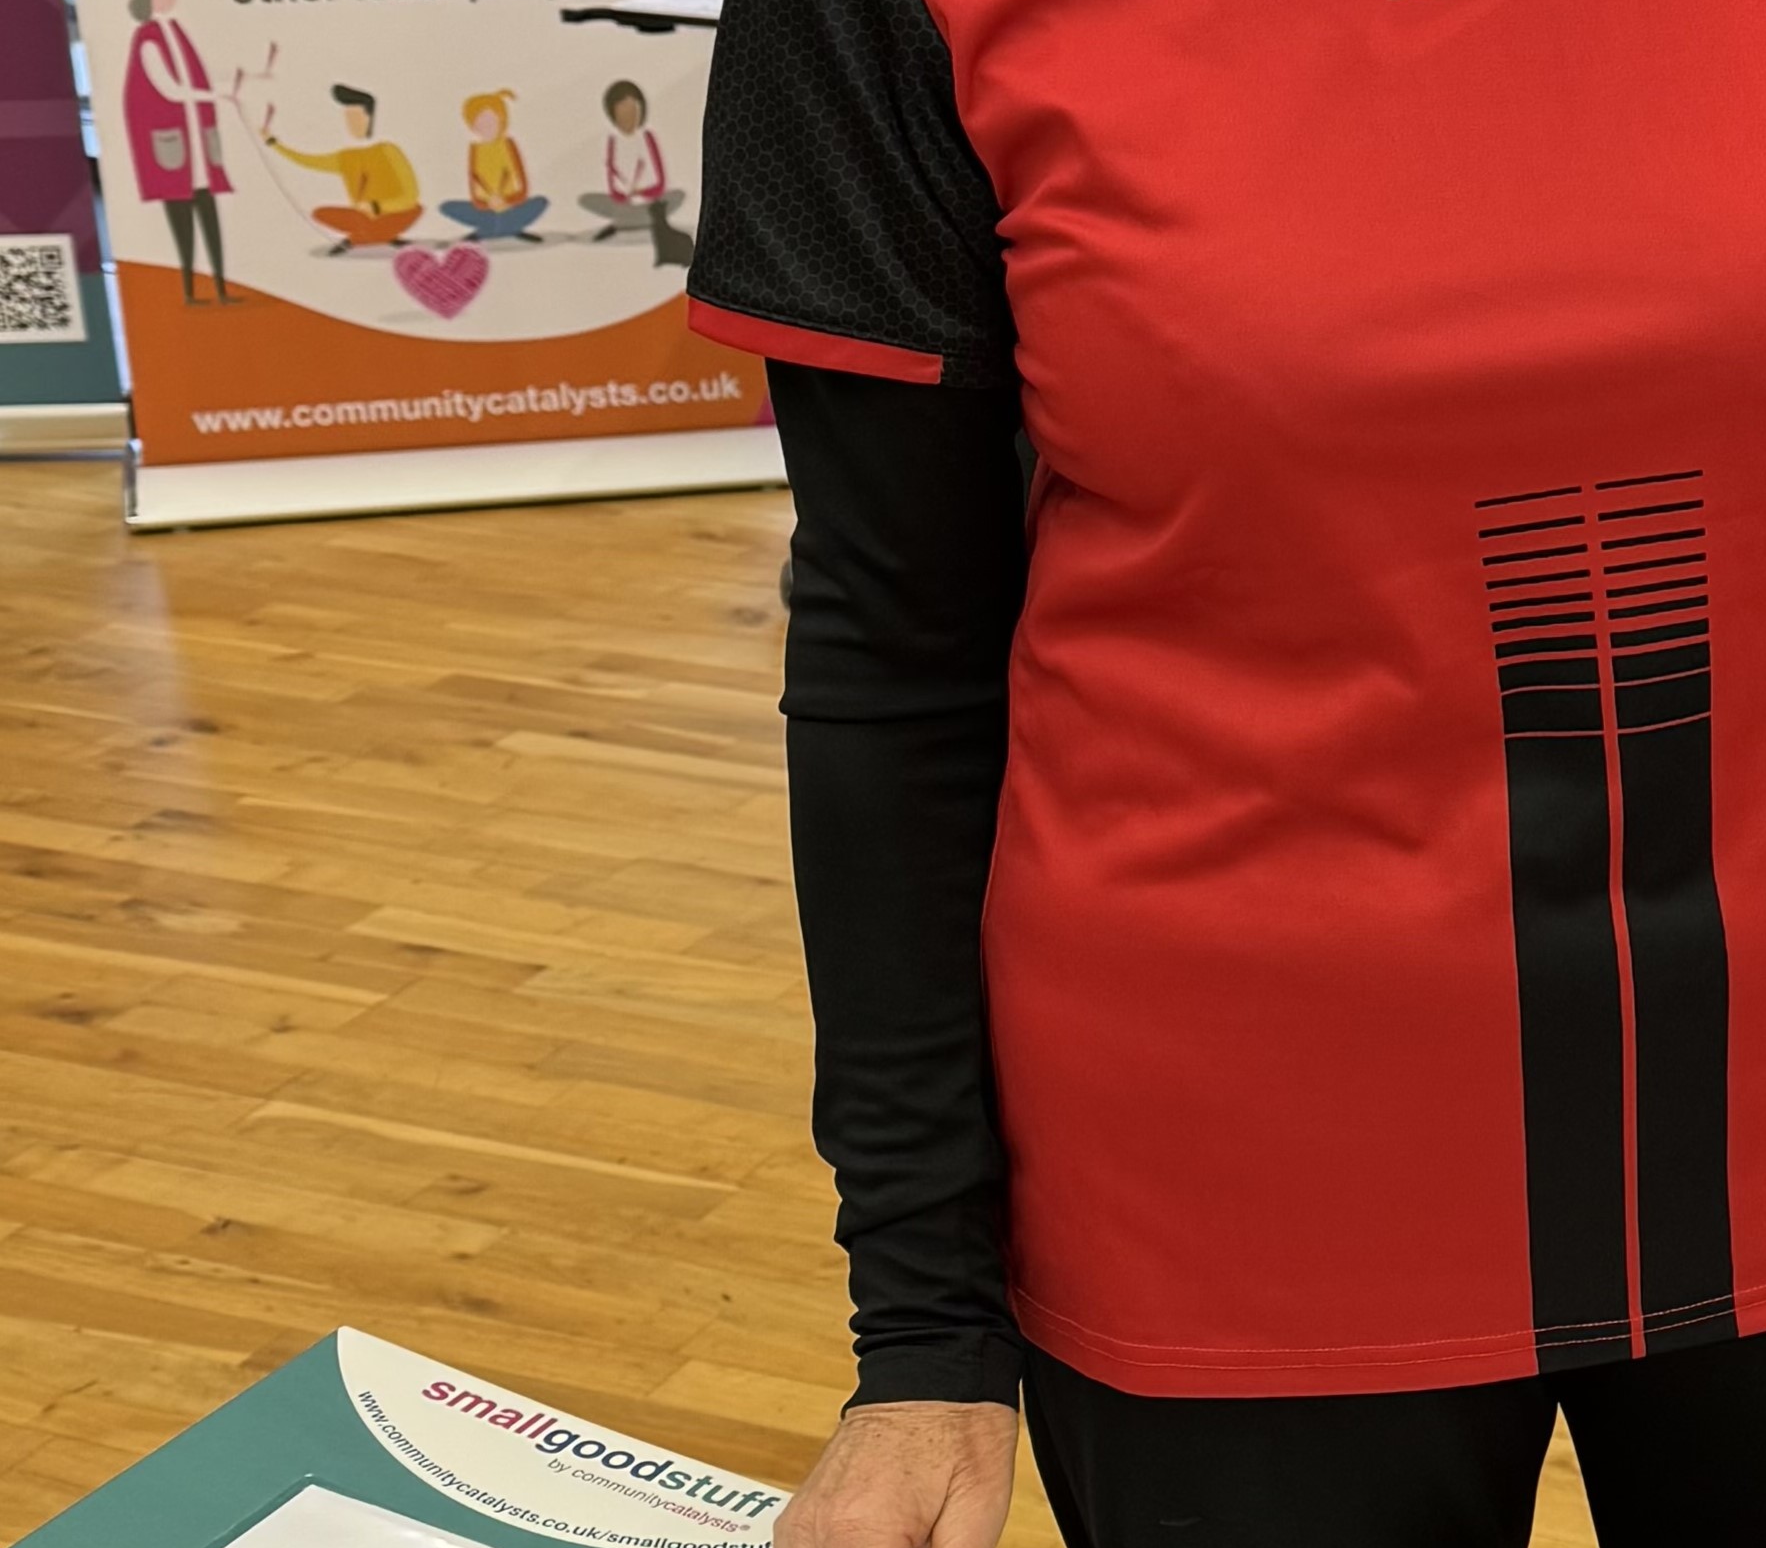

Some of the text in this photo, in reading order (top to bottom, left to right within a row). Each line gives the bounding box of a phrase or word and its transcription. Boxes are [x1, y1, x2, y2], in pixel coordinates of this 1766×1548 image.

[192, 373, 741, 434] www.communitycatalysts.co.uk
[422, 1377, 780, 1519] smallgoodstuff
[546, 1457, 565, 1477] by
